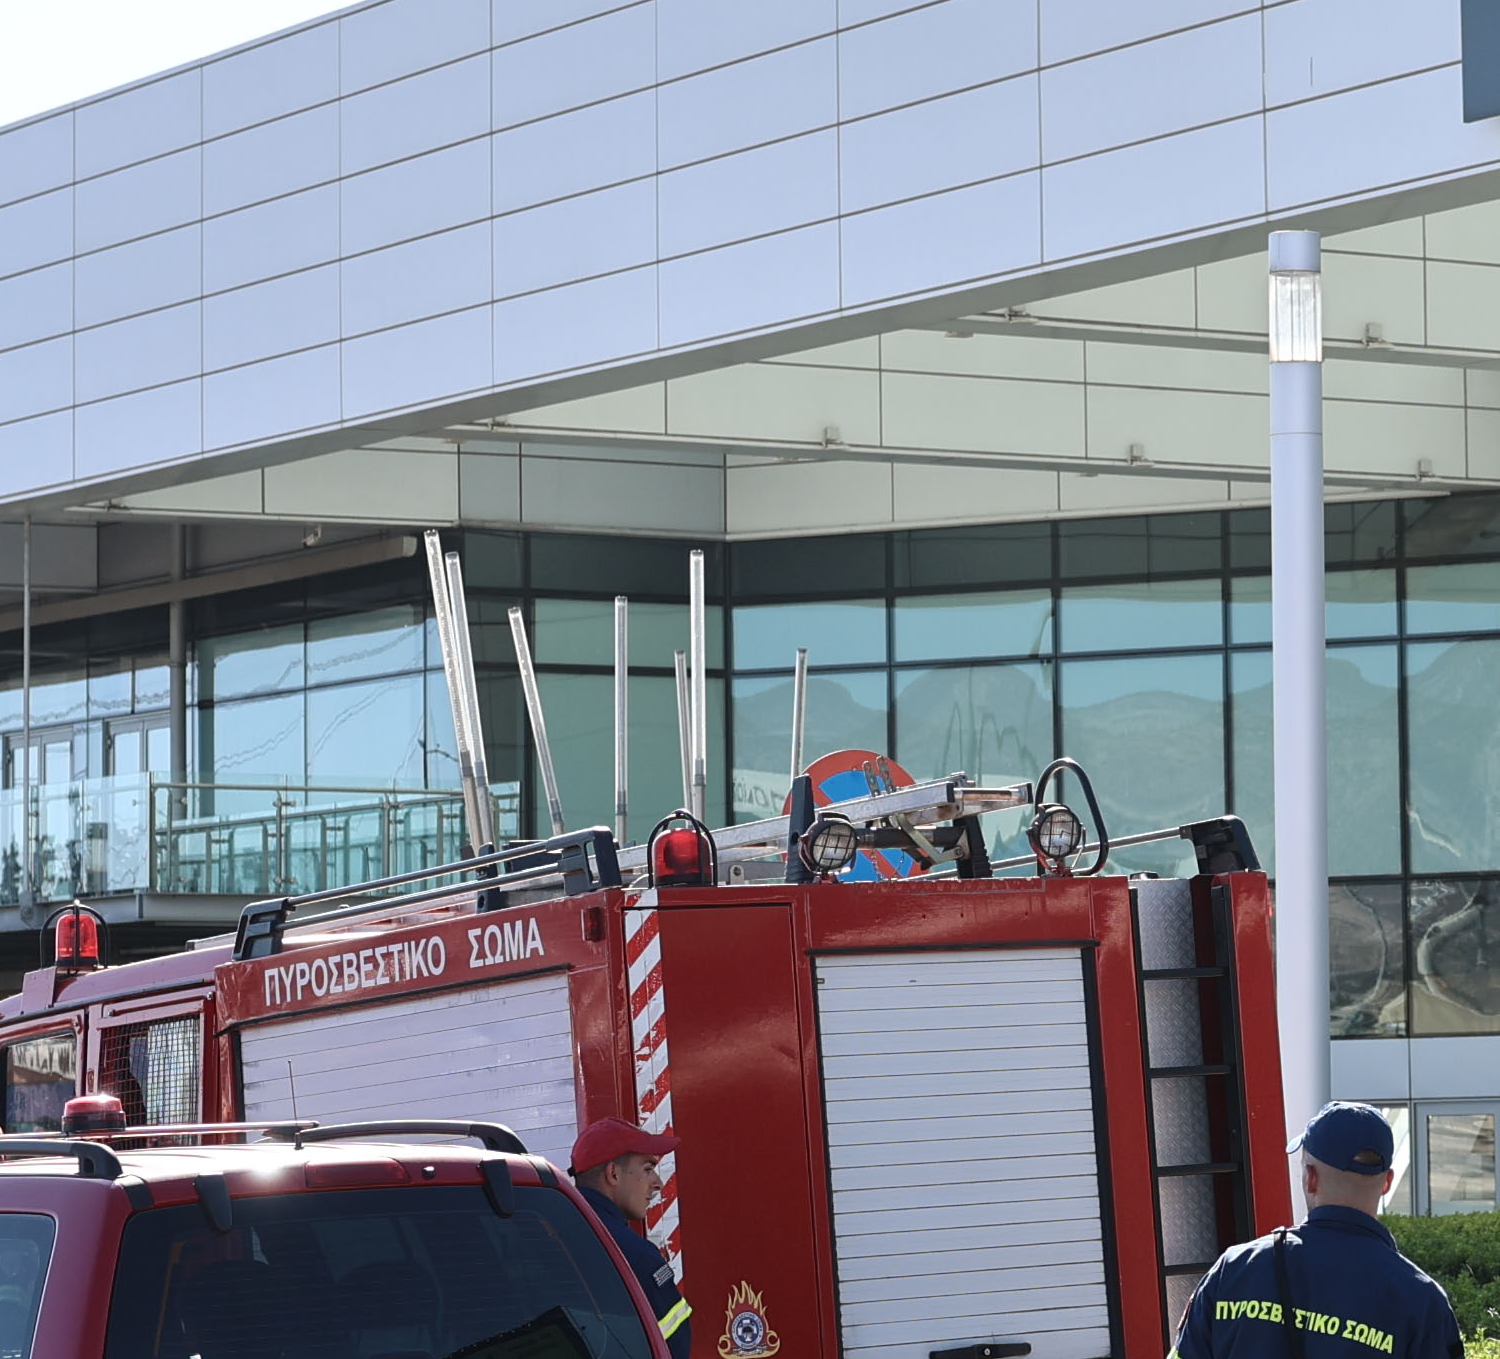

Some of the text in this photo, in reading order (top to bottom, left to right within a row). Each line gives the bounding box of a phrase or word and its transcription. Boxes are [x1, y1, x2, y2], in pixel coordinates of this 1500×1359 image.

[264, 917, 545, 1007] ΠΥΡΟΣΒΕΣΤΙΚΟ ΣΩΜΑ
[1342, 1319, 1394, 1354] ΣΩΜΑ
